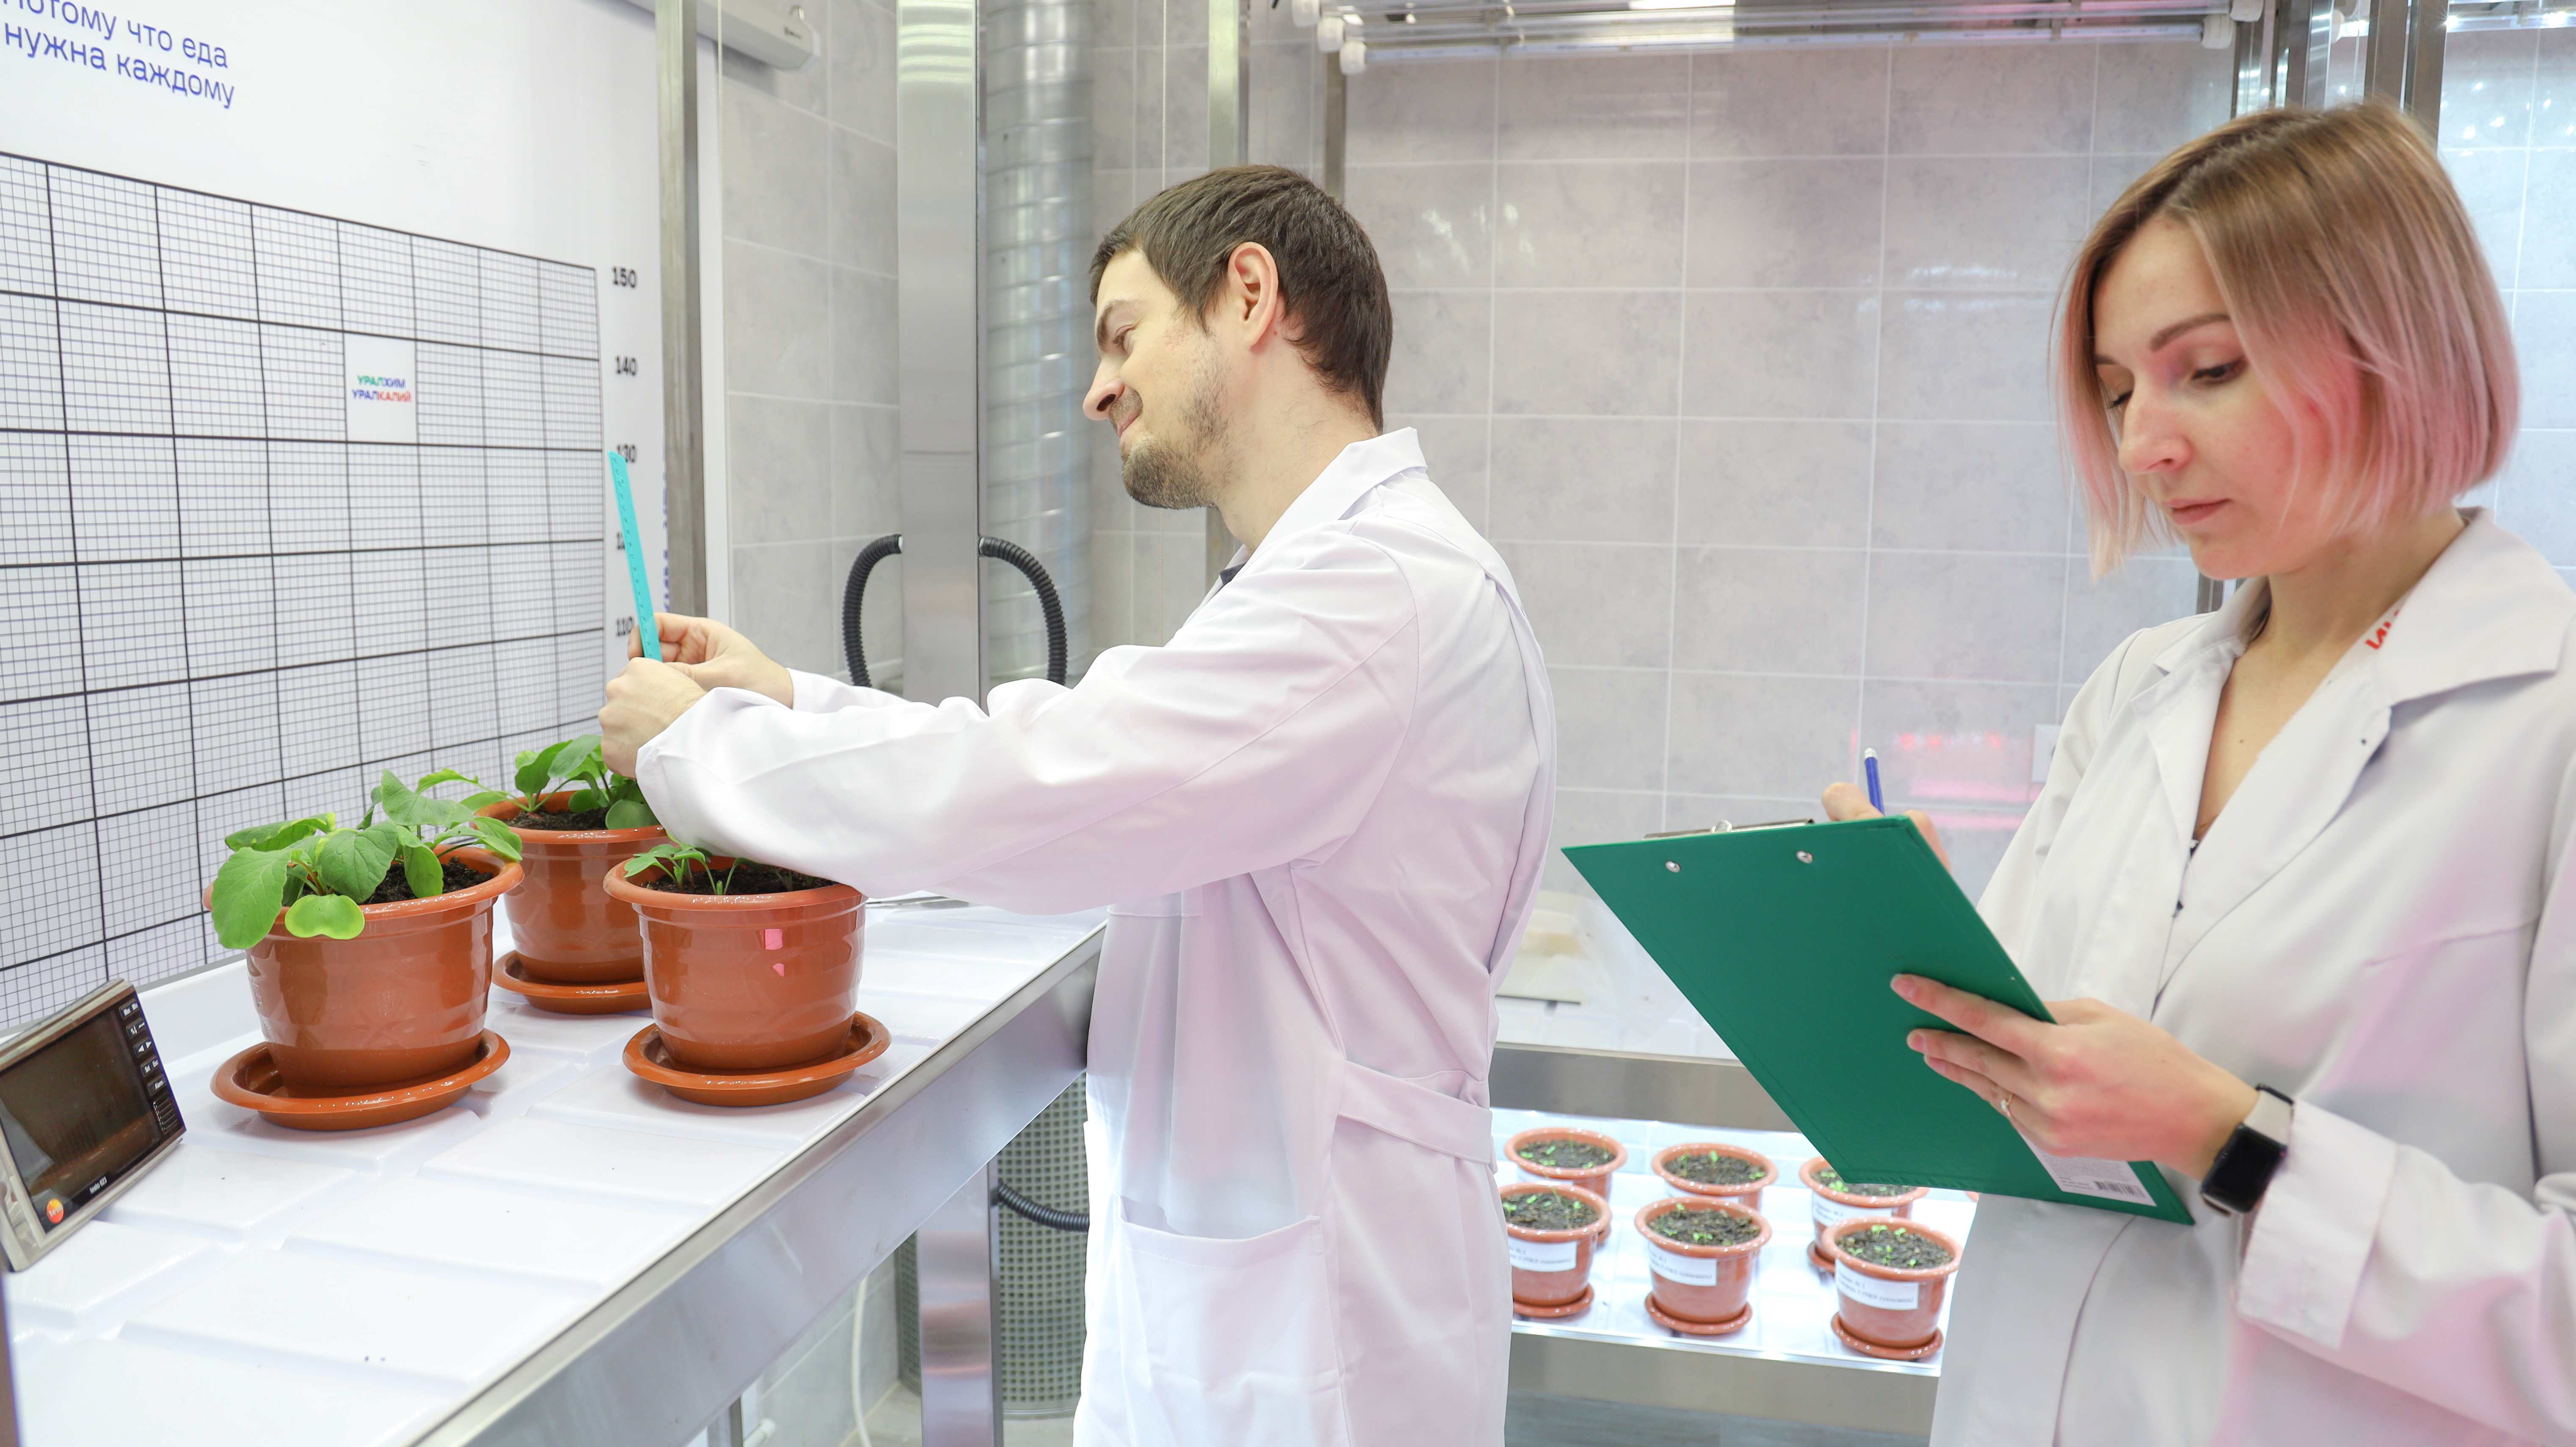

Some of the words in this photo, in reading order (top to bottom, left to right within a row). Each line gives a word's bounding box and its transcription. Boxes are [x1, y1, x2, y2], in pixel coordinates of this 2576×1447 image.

[127, 19, 173, 51] что
[183, 38, 229, 69] еда
[5, 22, 107, 71] нужна
[116, 53, 235, 109] каждому
[612, 267, 636, 288] 150
[616, 356, 637, 376] 140
[357, 375, 405, 388] УРАЛХИМ
[352, 390, 411, 402] УРАЛКАЛИЙ
